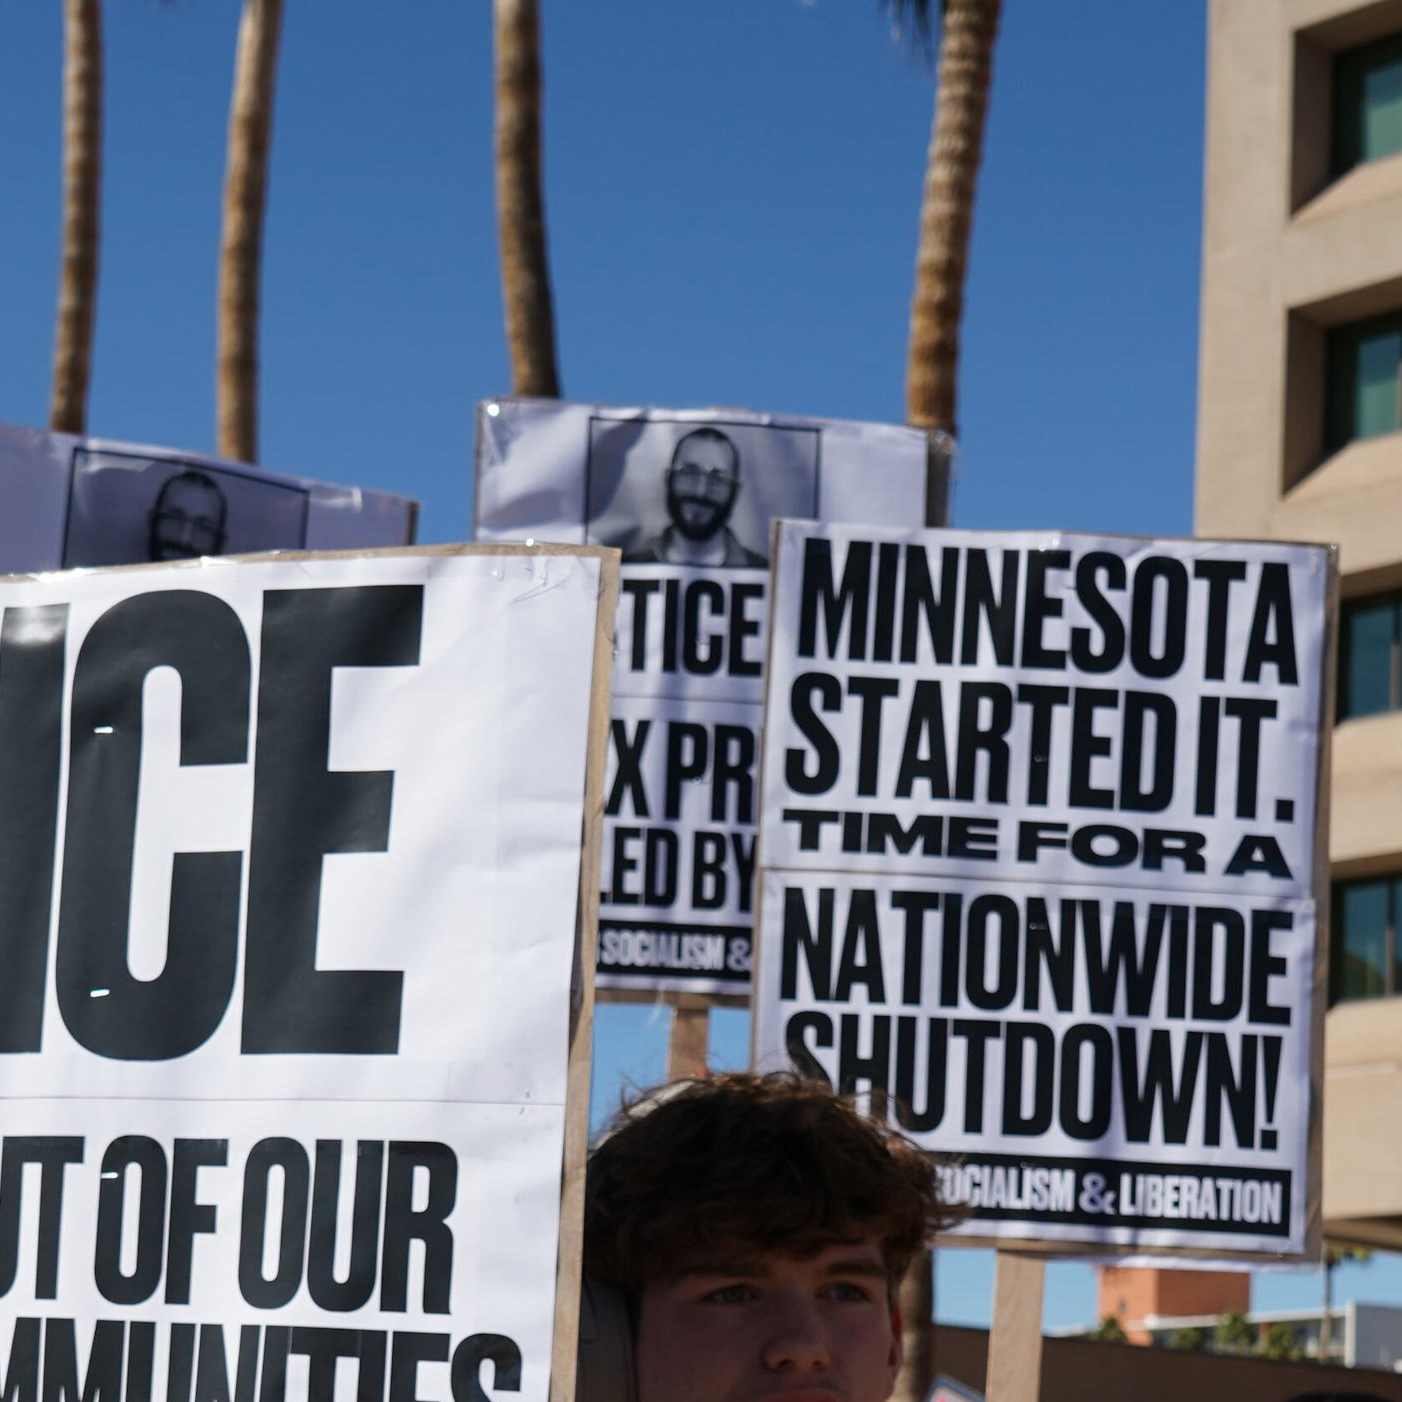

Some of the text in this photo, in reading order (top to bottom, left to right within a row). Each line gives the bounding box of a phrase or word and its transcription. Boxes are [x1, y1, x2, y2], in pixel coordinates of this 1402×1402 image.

[798, 537, 1300, 686] MINNESOTA
[664, 721, 755, 825] PR
[785, 672, 1295, 823] STARTED IT.
[600, 826, 758, 913] ED BY
[782, 807, 1294, 881] TIME FOR A
[602, 928, 725, 972] SOCIALISM
[779, 886, 1295, 1026] NATIONWIDE
[785, 1010, 1283, 1151] SHUTDOWN!
[94, 1134, 227, 1305] OF
[238, 1138, 458, 1315] OUR
[1080, 1172, 1116, 1215] &
[1120, 1173, 1283, 1224] LIBERATION
